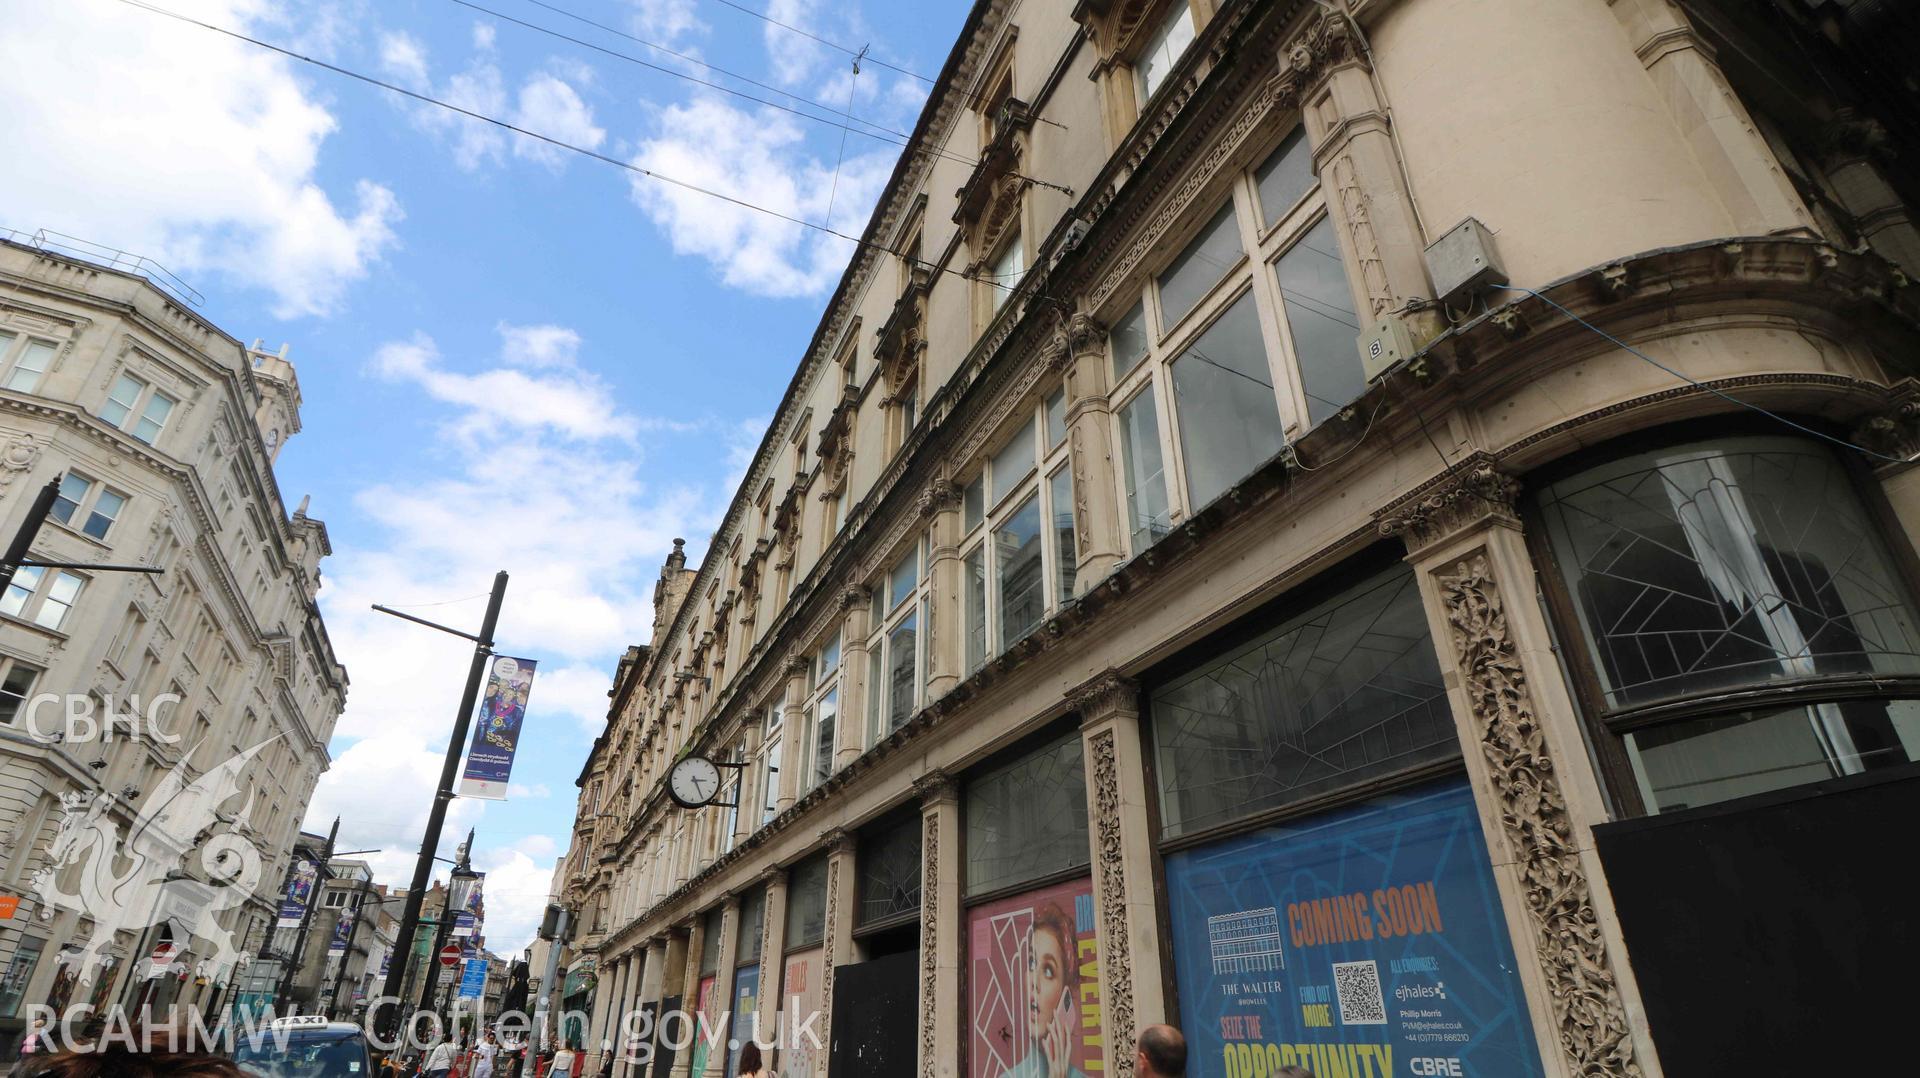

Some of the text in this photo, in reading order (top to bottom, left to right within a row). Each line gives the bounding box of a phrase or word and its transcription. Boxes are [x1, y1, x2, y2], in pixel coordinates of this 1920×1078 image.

[1371, 343, 1380, 356] 8
[1287, 881, 1443, 948] COMING SOON
[1222, 981, 1282, 995] THE WALTER
[1300, 985, 1331, 1004] FIND OUT
[1395, 984, 1434, 1001] ejhales
[278, 1016, 323, 1026] TAXI
[1302, 1004, 1332, 1027] MORE
[1420, 1009, 1442, 1017] Morris
[1220, 1015, 1263, 1039] SEIZE THE
[1410, 1057, 1463, 1077] CBRE
